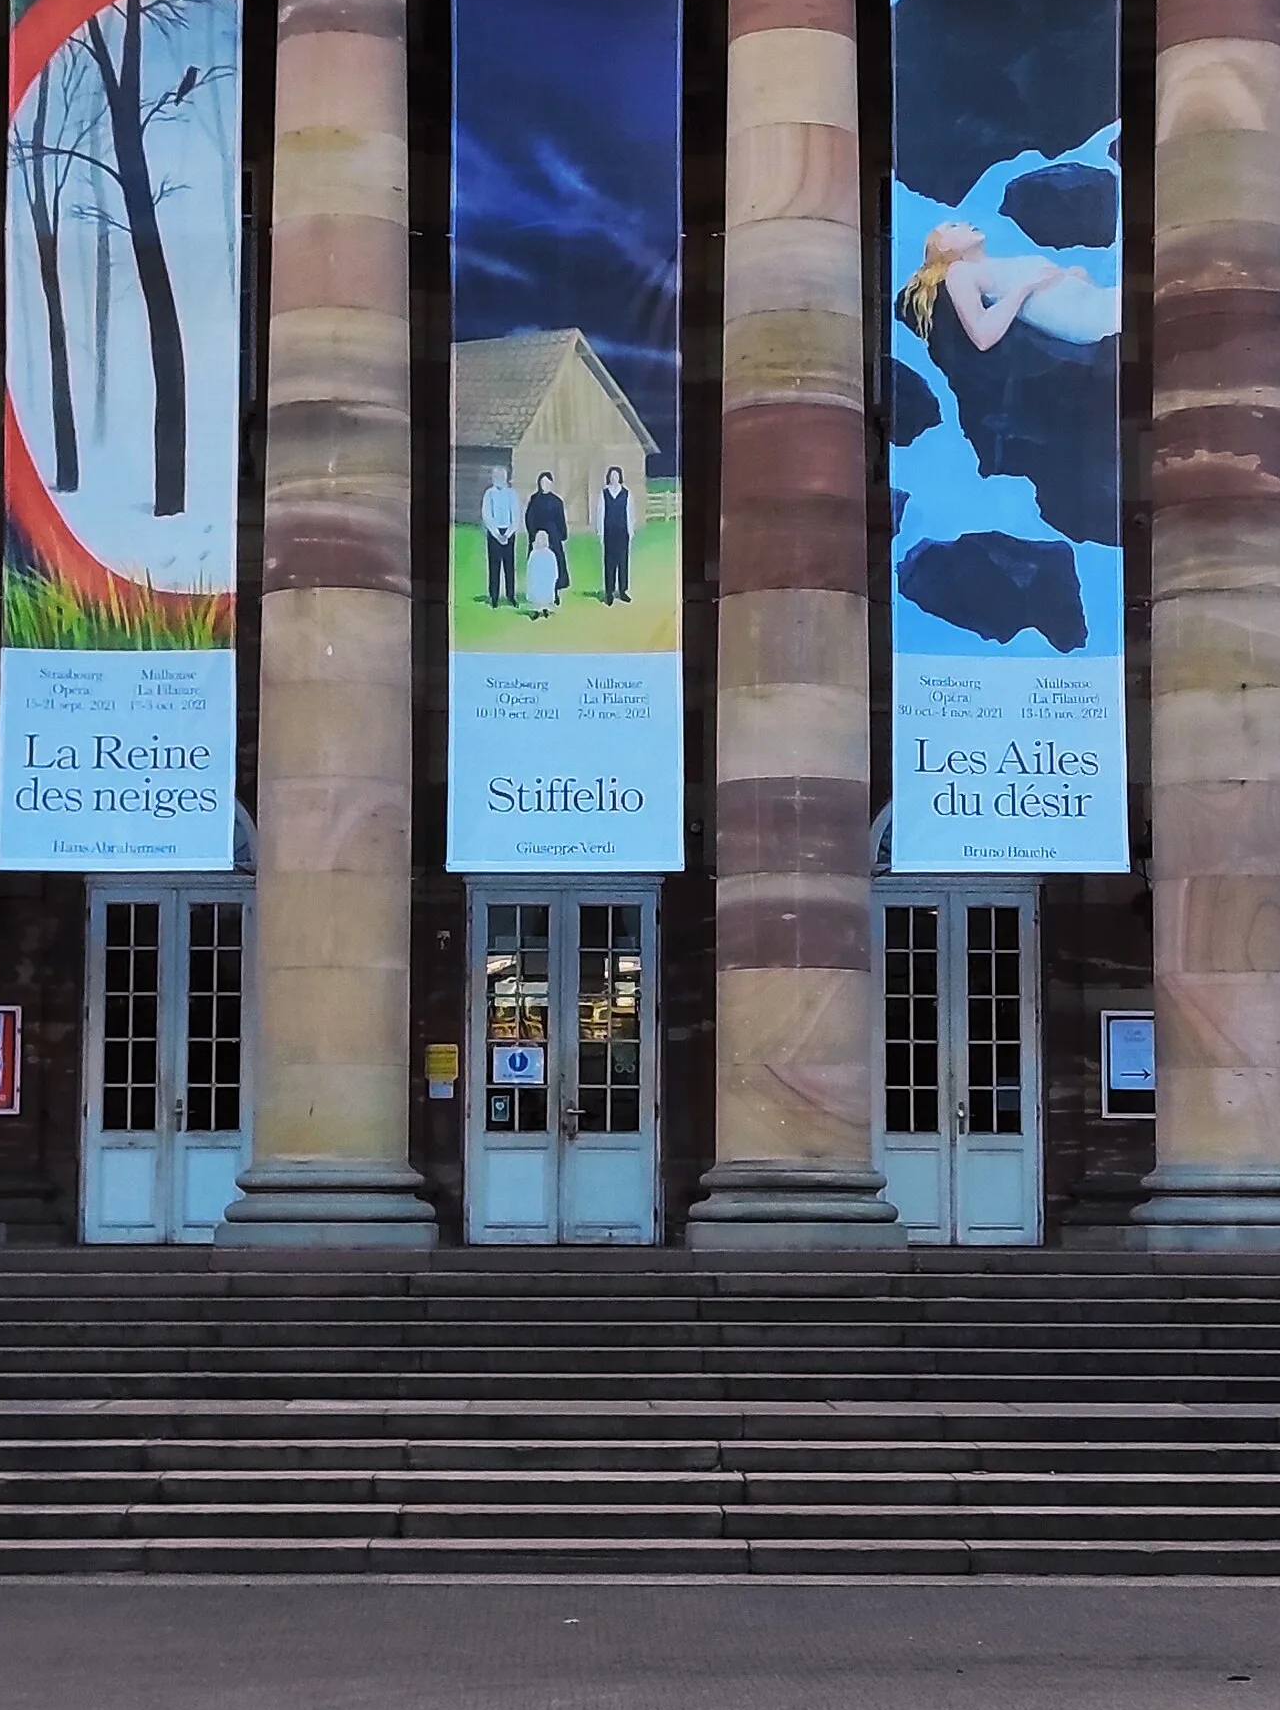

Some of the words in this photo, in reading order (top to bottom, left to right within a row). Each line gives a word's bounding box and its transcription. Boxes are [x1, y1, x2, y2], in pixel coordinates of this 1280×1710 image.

[39, 668, 103, 682] Strasbourg
[141, 669, 197, 681] Mulhouse
[486, 677, 549, 691] Strasbourg
[586, 678, 644, 690] Mulhouse
[919, 676, 981, 690] Strasbourg
[1036, 677, 1092, 689] Mulhouse
[89, 700, 116, 711] 2021
[180, 699, 207, 711] 2021
[533, 709, 559, 720] 2021
[624, 708, 651, 720] 2021
[976, 707, 1003, 719] 2021
[1081, 707, 1108, 719] 2021
[23, 733, 80, 770] La
[91, 735, 210, 771] Reine
[914, 738, 987, 775] Les
[995, 740, 1100, 776] Ailes
[15, 776, 83, 813] des
[93, 777, 217, 819] neiges
[487, 776, 645, 813] Stiffelio
[932, 782, 984, 816] du
[993, 783, 1093, 818] désir
[52, 839, 89, 854] Hans
[91, 839, 177, 854] Abrahamsen
[516, 841, 578, 855] Giuseppe
[579, 841, 615, 854] Verdi
[963, 845, 1005, 858] Bruno
